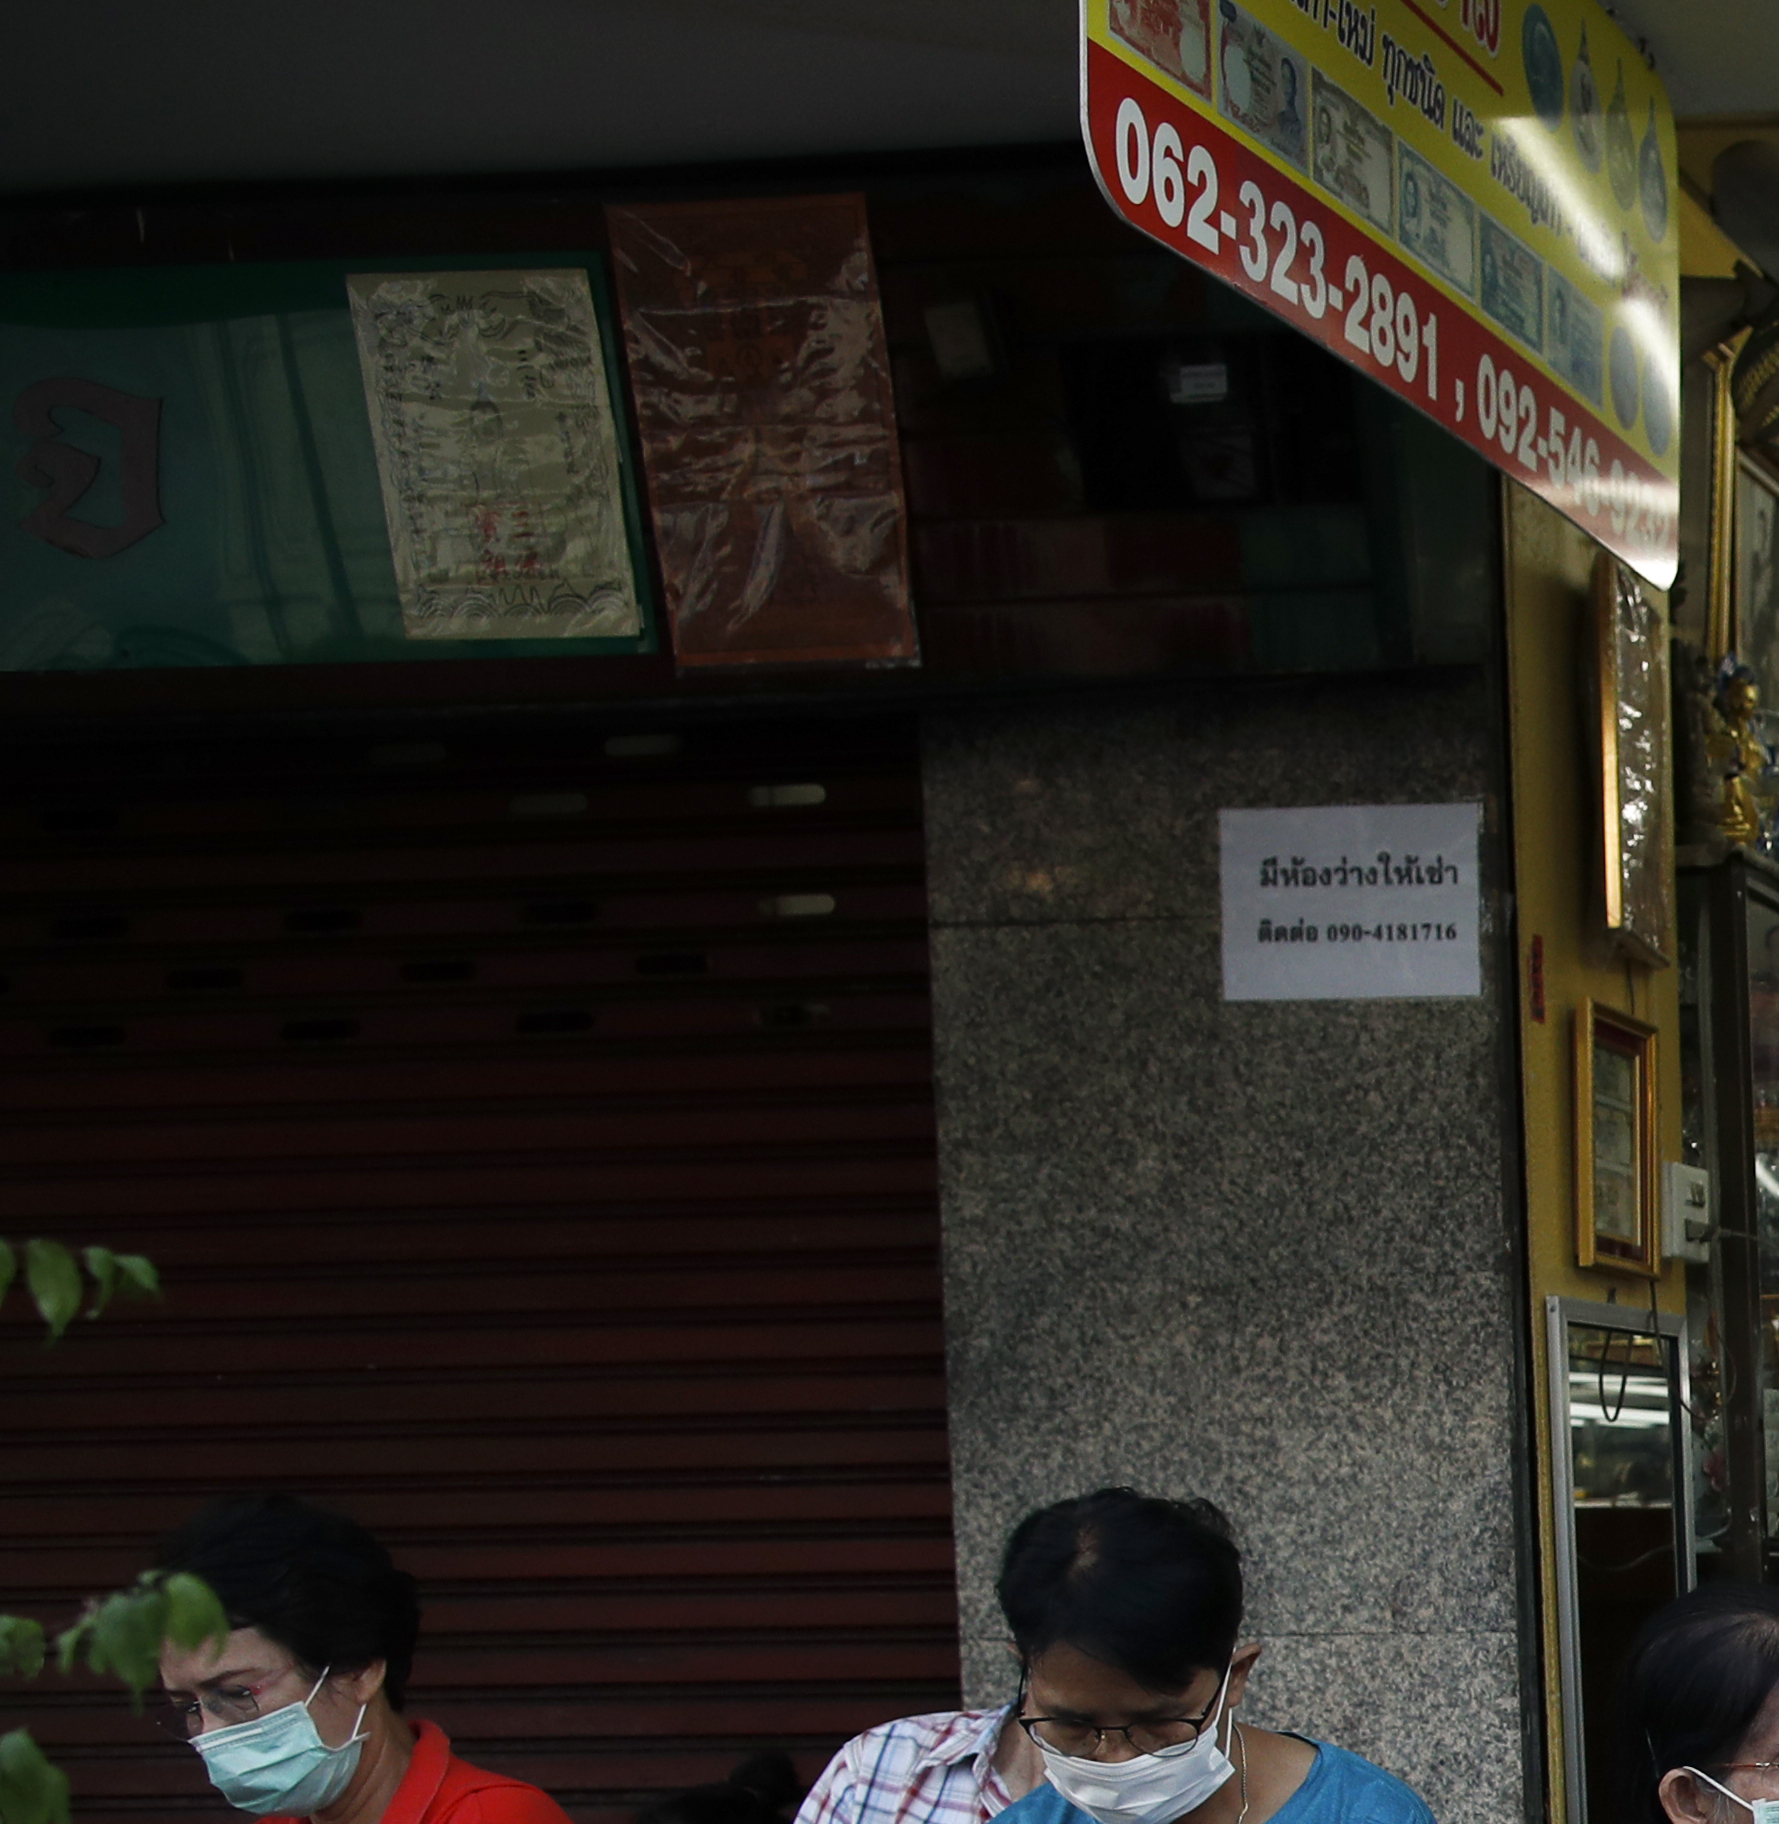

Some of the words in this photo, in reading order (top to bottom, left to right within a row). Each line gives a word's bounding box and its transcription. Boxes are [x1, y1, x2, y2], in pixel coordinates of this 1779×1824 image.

[1115, 97, 1437, 401] 062-323-2891
[1260, 851, 1458, 887] มีห้องว่างให้เช่า
[1327, 923, 1457, 942] 090-4181716
